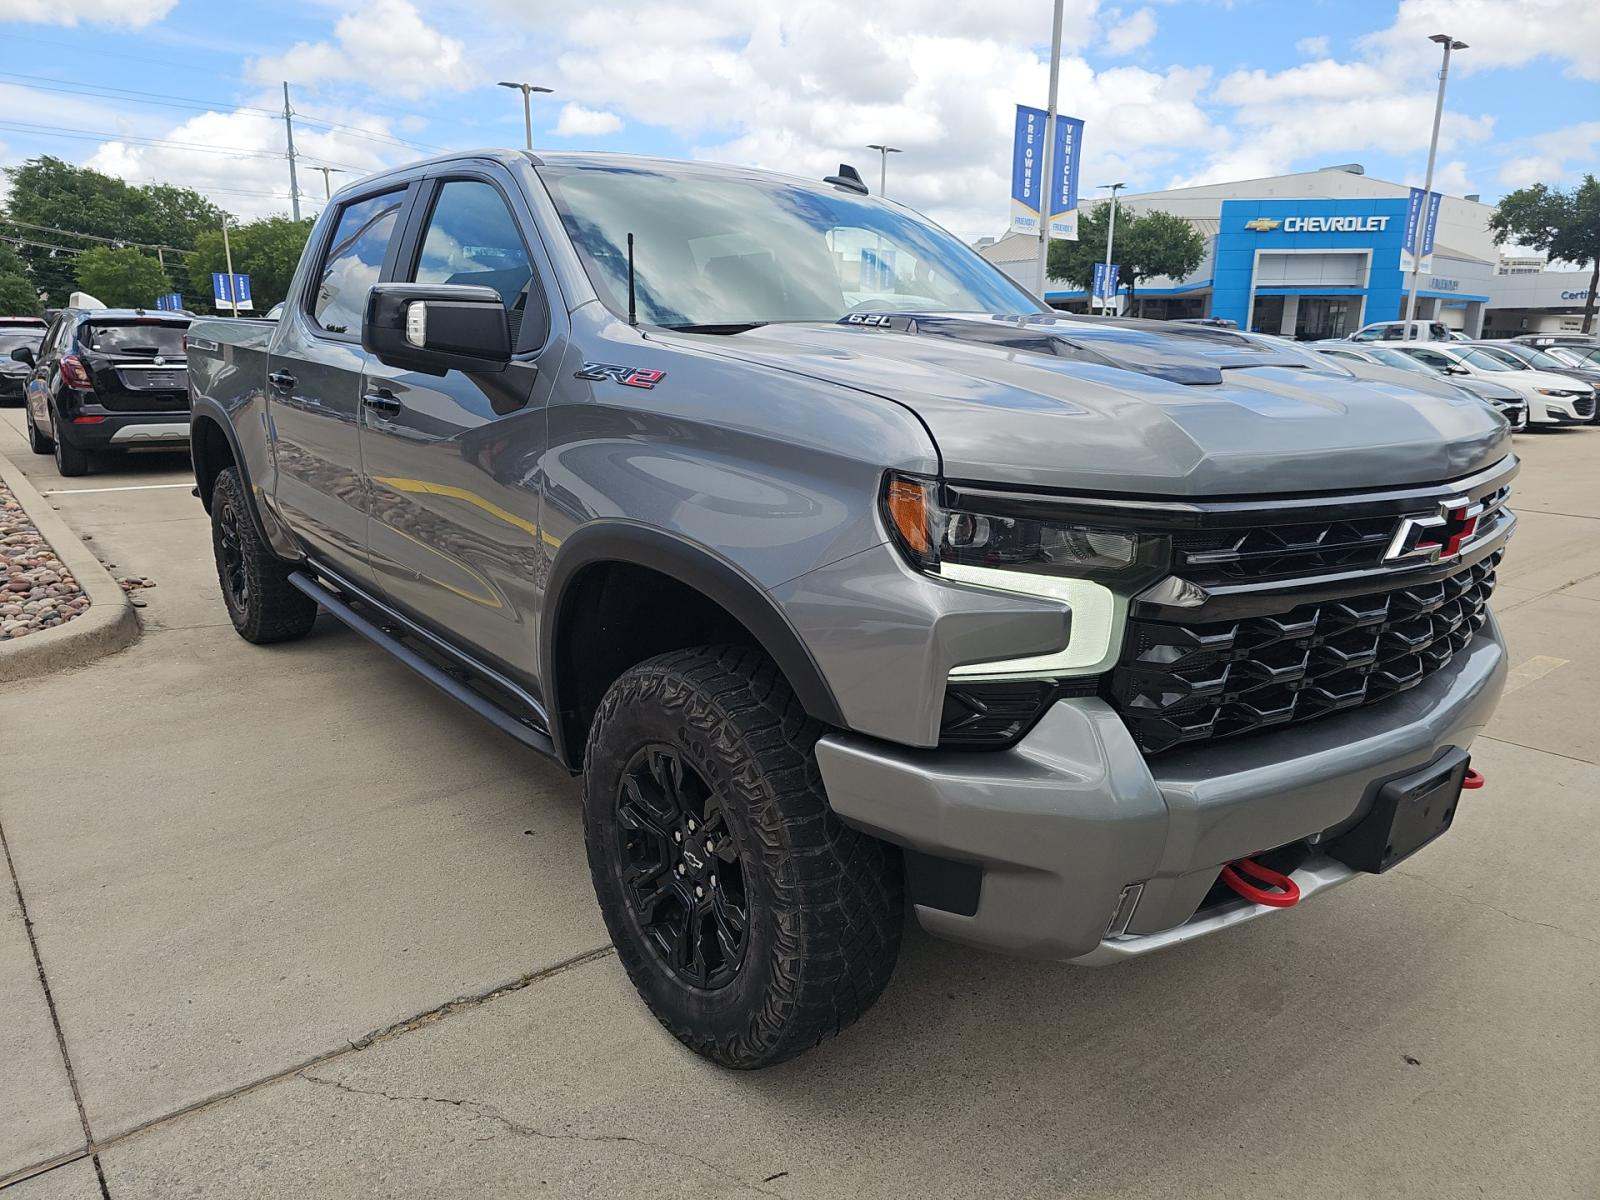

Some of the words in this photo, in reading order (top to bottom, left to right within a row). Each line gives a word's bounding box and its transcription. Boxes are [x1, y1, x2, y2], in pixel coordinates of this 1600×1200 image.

[1027, 113, 1035, 144] PRE
[1023, 148, 1034, 198] OWNED
[1062, 124, 1074, 205] VEHICLES
[1284, 216, 1390, 232] CHEVROLET
[1561, 290, 1600, 300] Certi
[573, 360, 667, 390] ZR2
